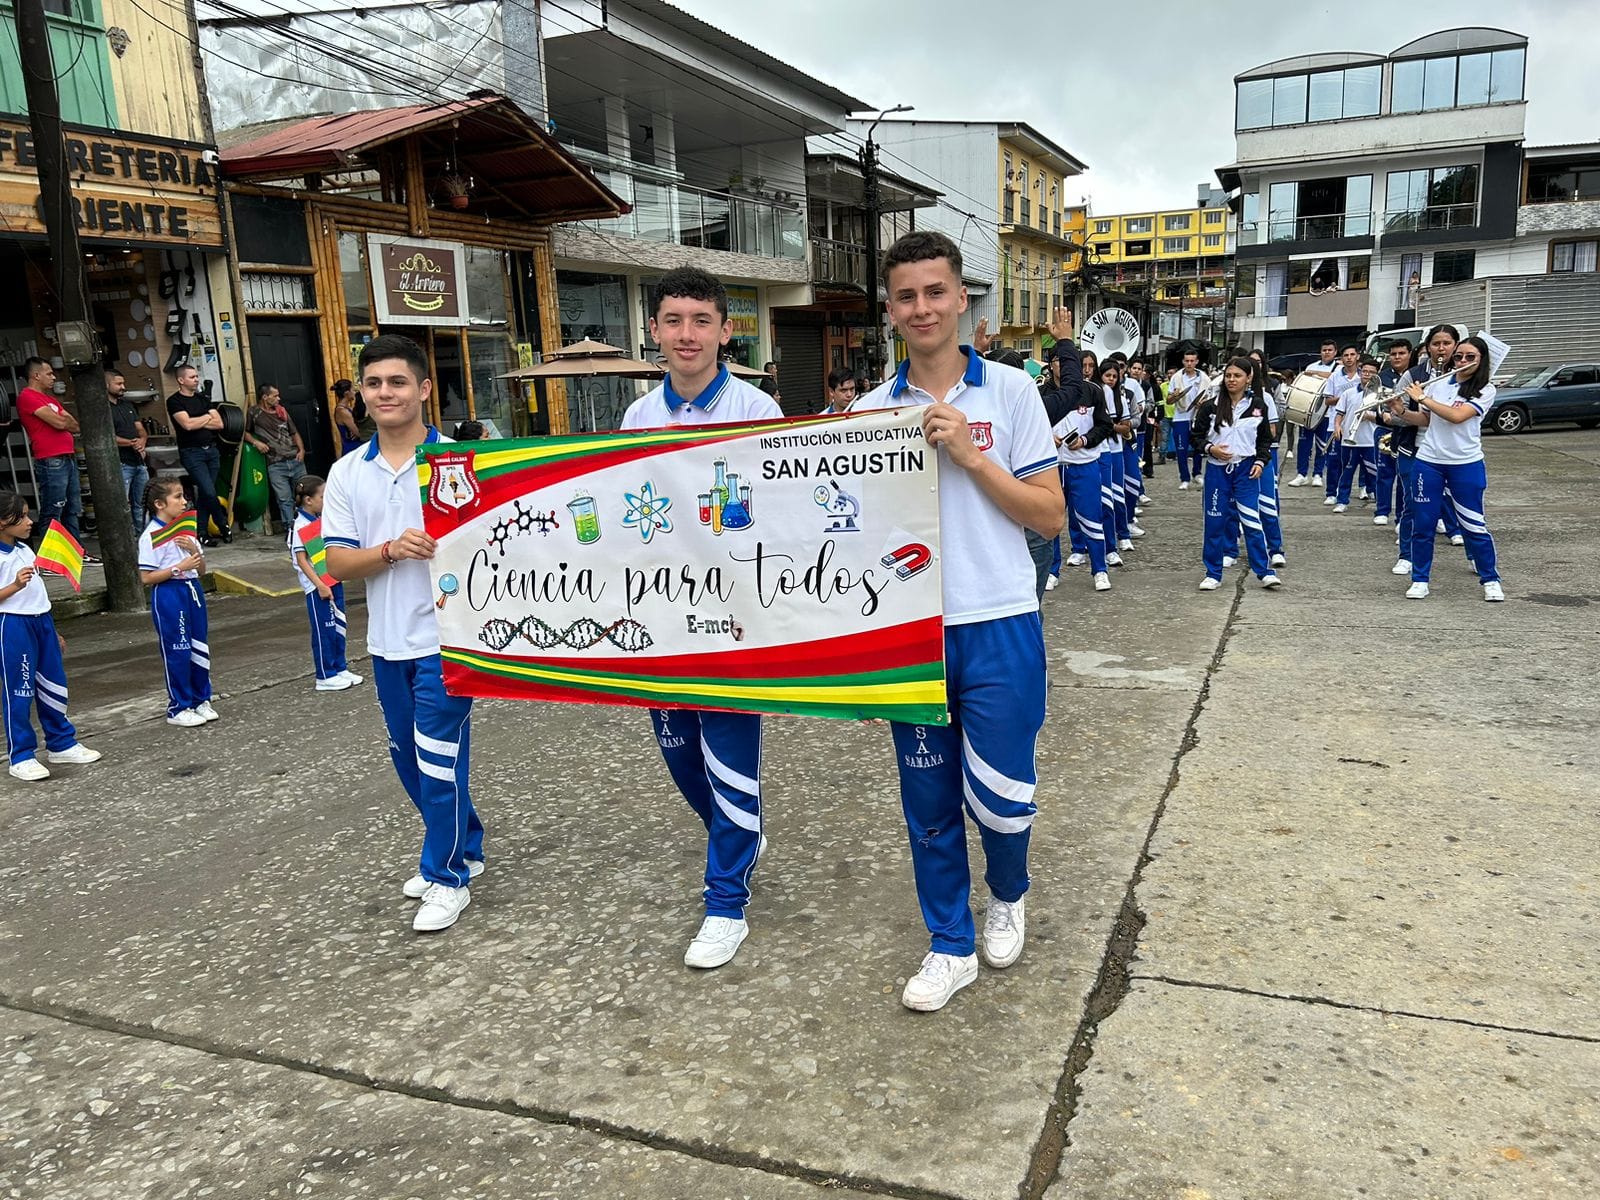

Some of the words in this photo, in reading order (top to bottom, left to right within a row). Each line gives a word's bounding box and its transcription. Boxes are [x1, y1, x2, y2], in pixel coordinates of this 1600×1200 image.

[38, 194, 189, 238] RIENTE
[410, 273, 446, 292] Arriero
[1092, 310, 1109, 330] SAN
[1114, 309, 1139, 342] AGUSTIN
[760, 430, 842, 450] INSTITUCIÓN
[846, 426, 924, 444] EDUCATIVA
[762, 457, 809, 480] SAN
[815, 445, 924, 478] AGUSTÍN
[467, 549, 606, 612] Ciencia
[625, 564, 733, 617] para
[729, 539, 889, 616] todos
[904, 754, 944, 768] SAMANA
